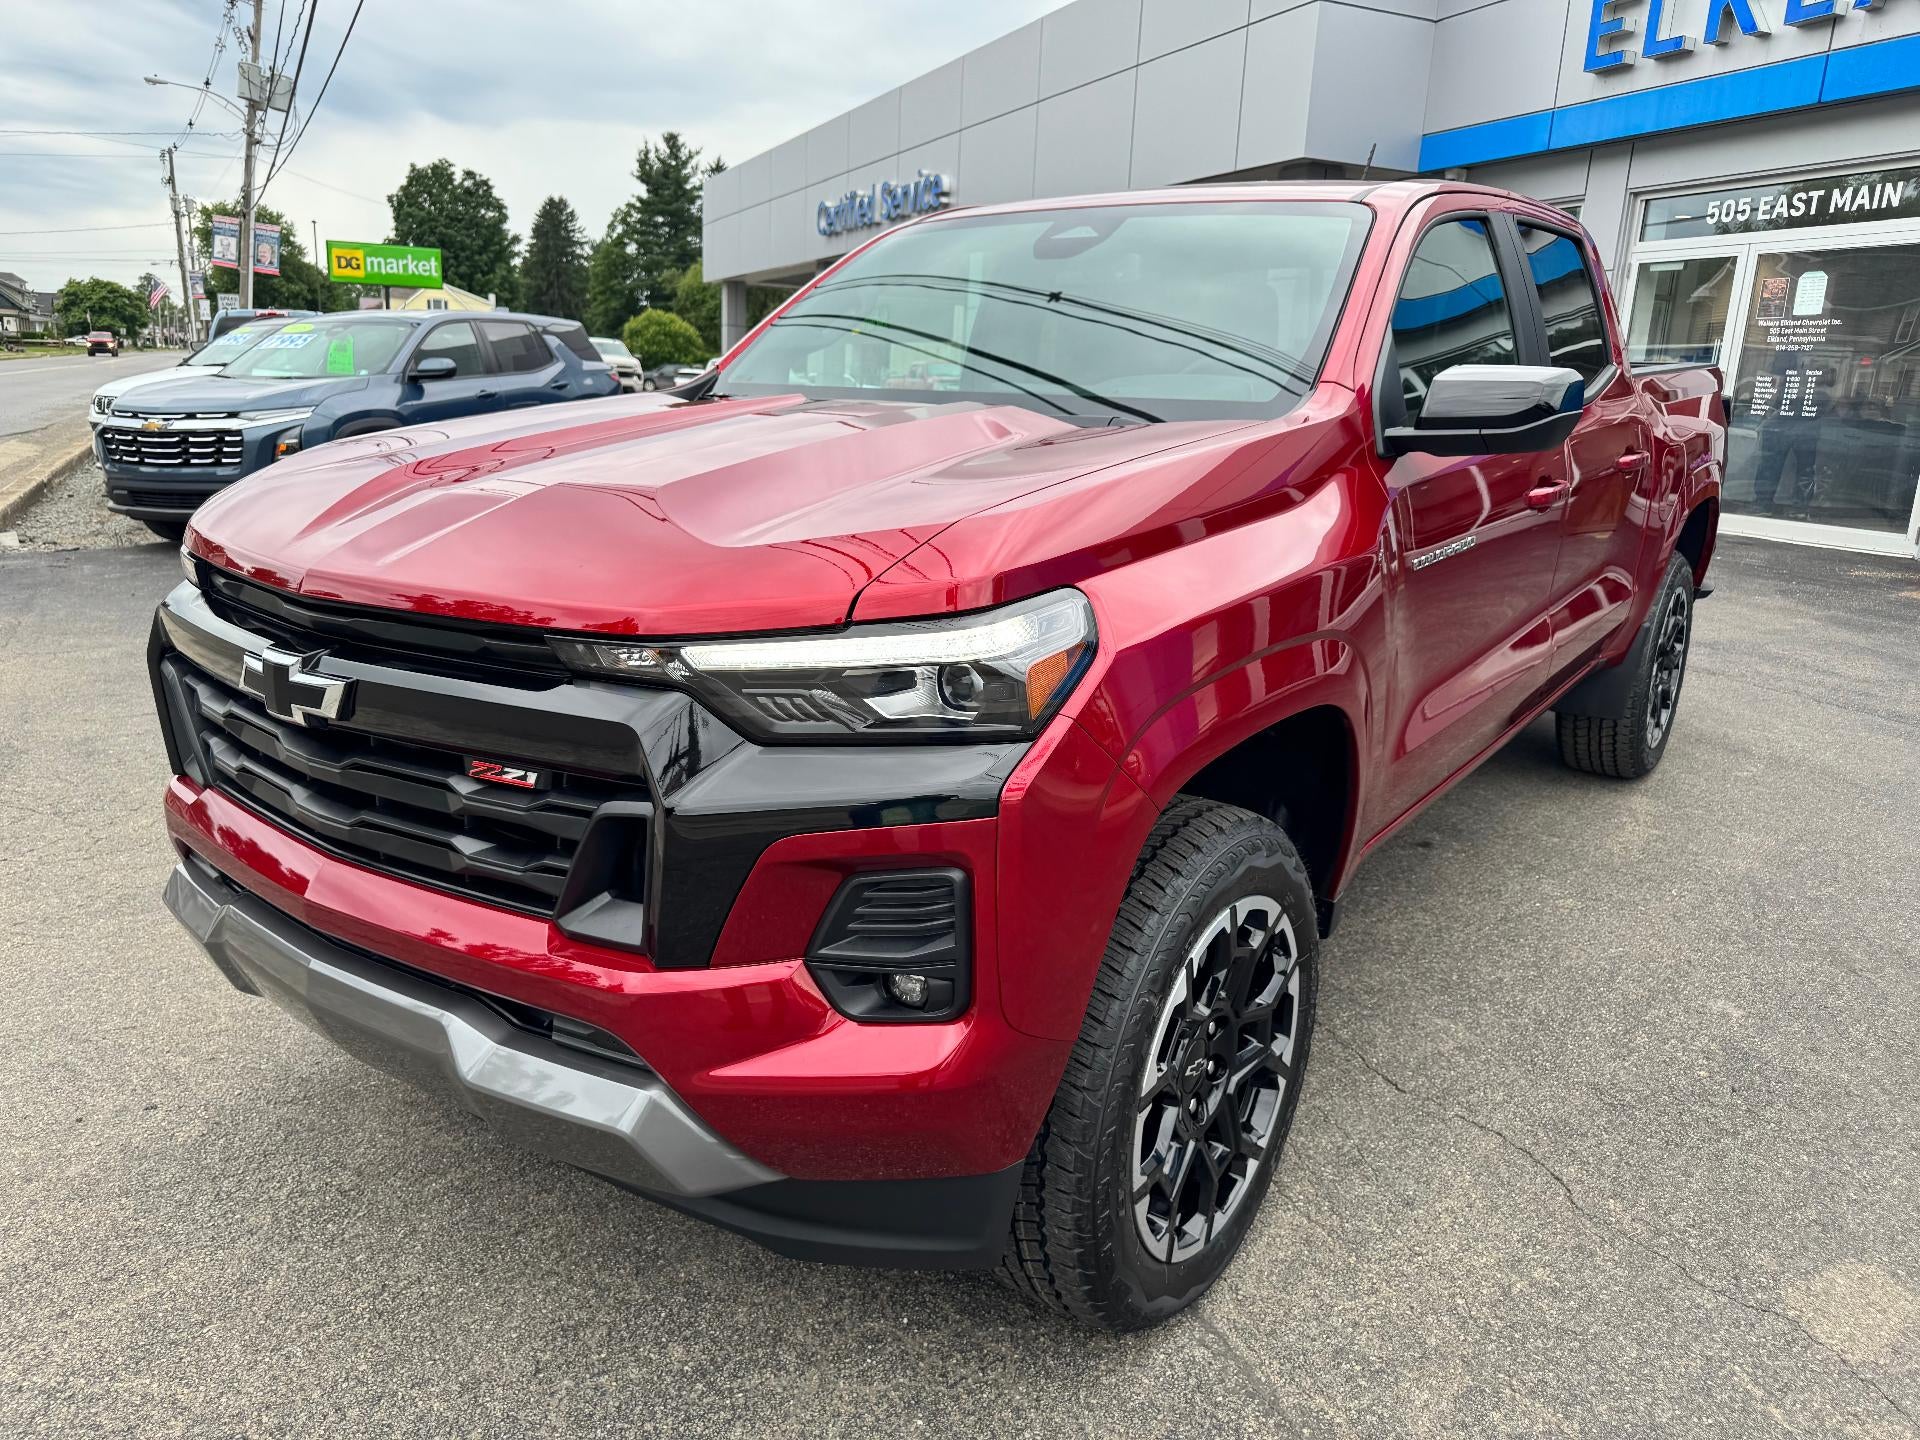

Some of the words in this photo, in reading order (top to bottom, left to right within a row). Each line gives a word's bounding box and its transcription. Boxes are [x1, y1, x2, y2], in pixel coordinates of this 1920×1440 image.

[817, 183, 876, 237] Certified
[881, 169, 944, 221] Service
[1705, 197, 1752, 225] 505
[1756, 189, 1825, 221] EAST
[1828, 180, 1904, 214] MAIN
[335, 255, 361, 270] DG
[366, 254, 439, 277] market
[1802, 318, 1831, 326] Chevrolet
[1788, 335, 1826, 343] Pennsylvania
[468, 760, 538, 789] Z71
